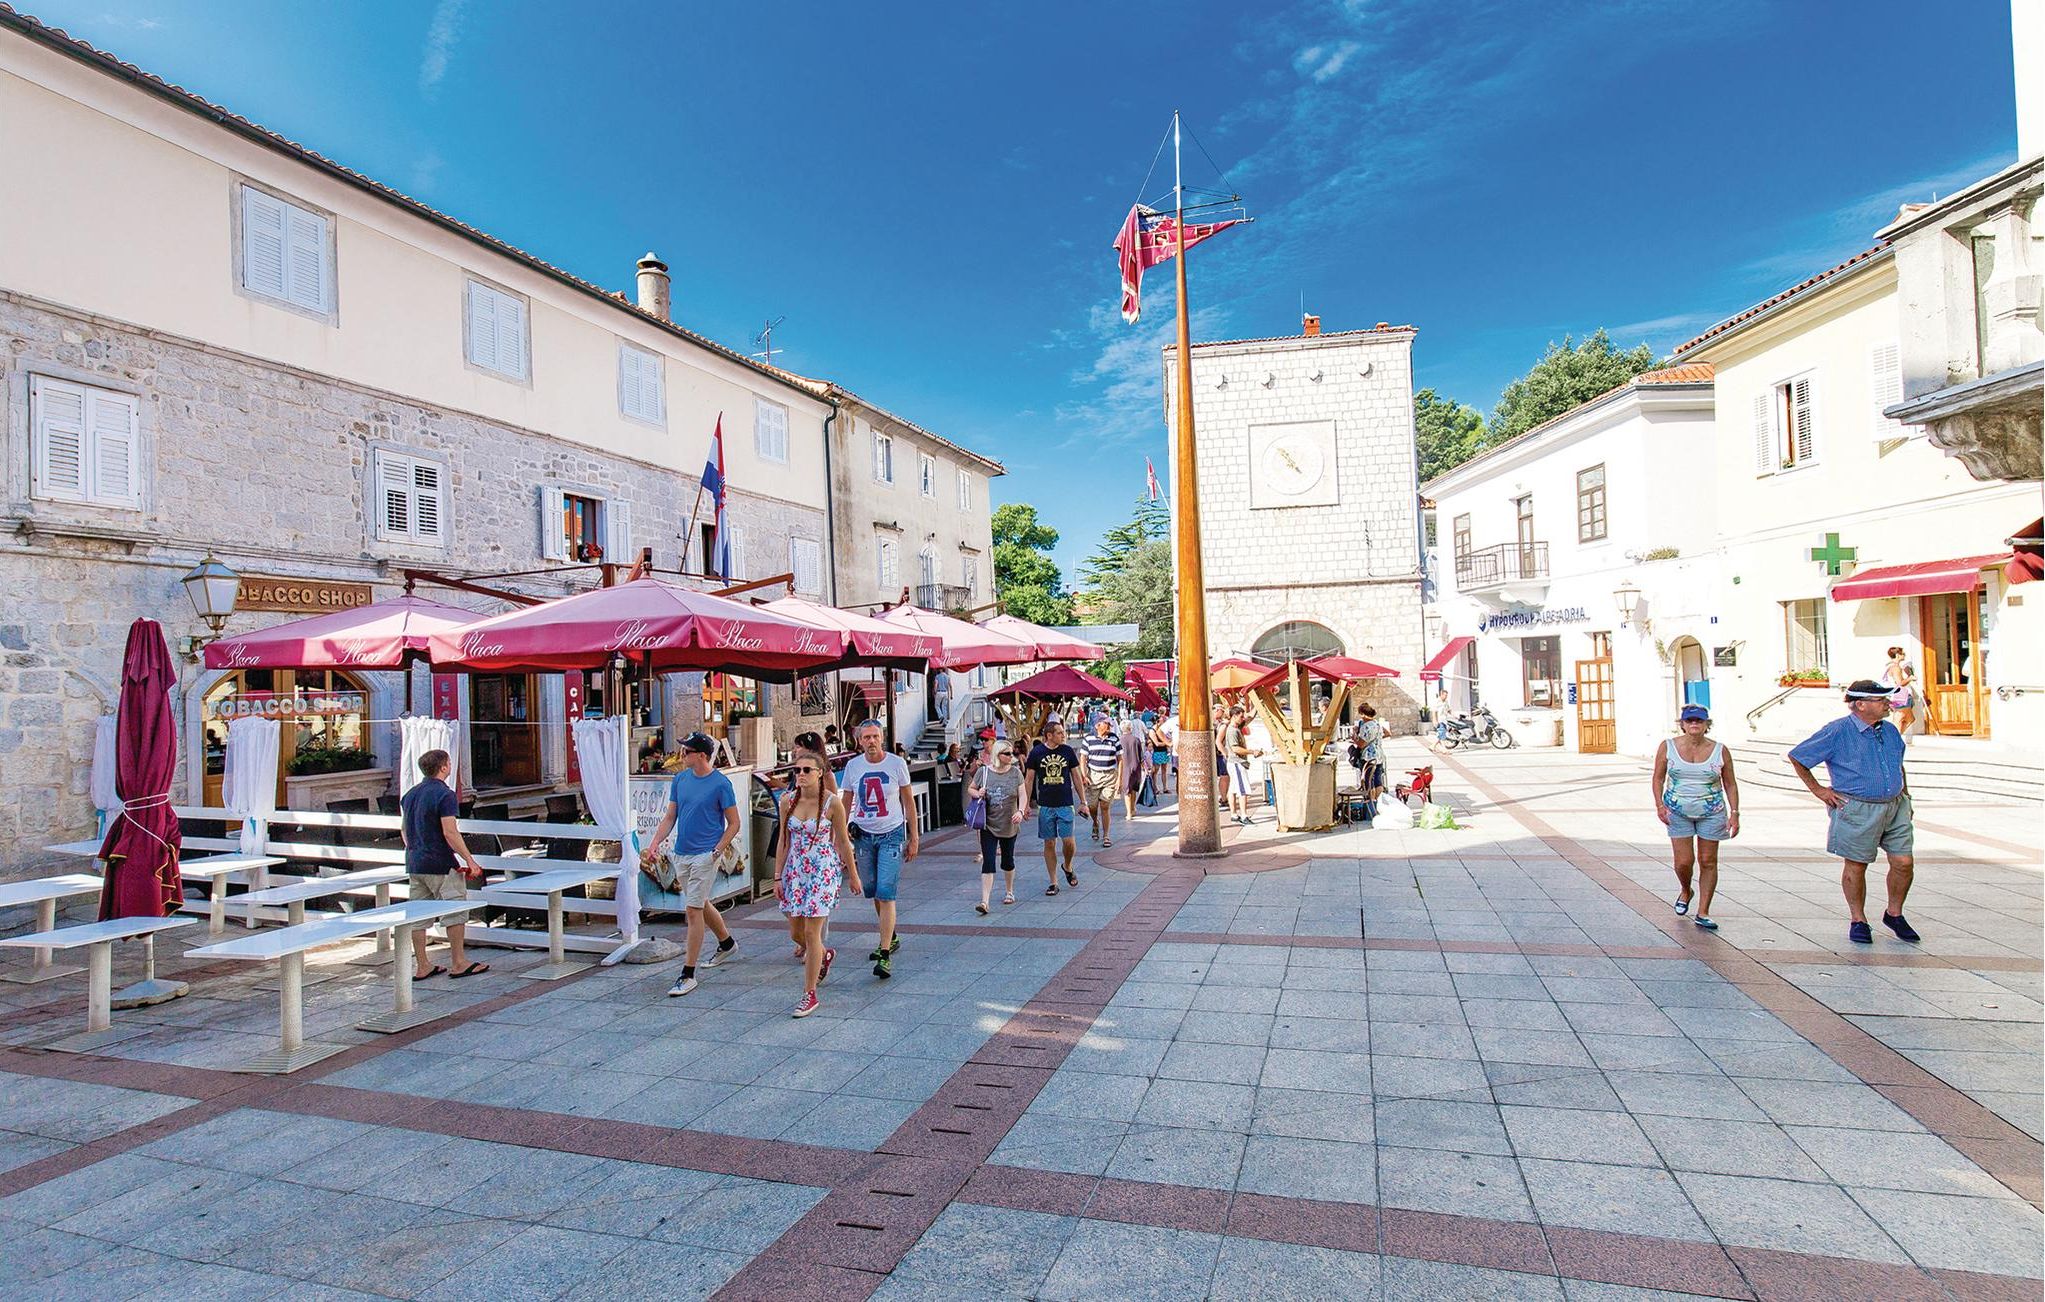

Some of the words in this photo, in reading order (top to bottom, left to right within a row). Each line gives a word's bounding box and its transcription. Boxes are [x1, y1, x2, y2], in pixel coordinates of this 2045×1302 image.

[237, 586, 313, 604] OBACCO
[319, 589, 366, 607] SHOP
[452, 631, 504, 660] Placa
[604, 618, 670, 650] Placa
[716, 619, 763, 649] Placa
[790, 626, 828, 654] Placa
[207, 698, 307, 717] TOBACCO
[314, 696, 363, 713] SHOP
